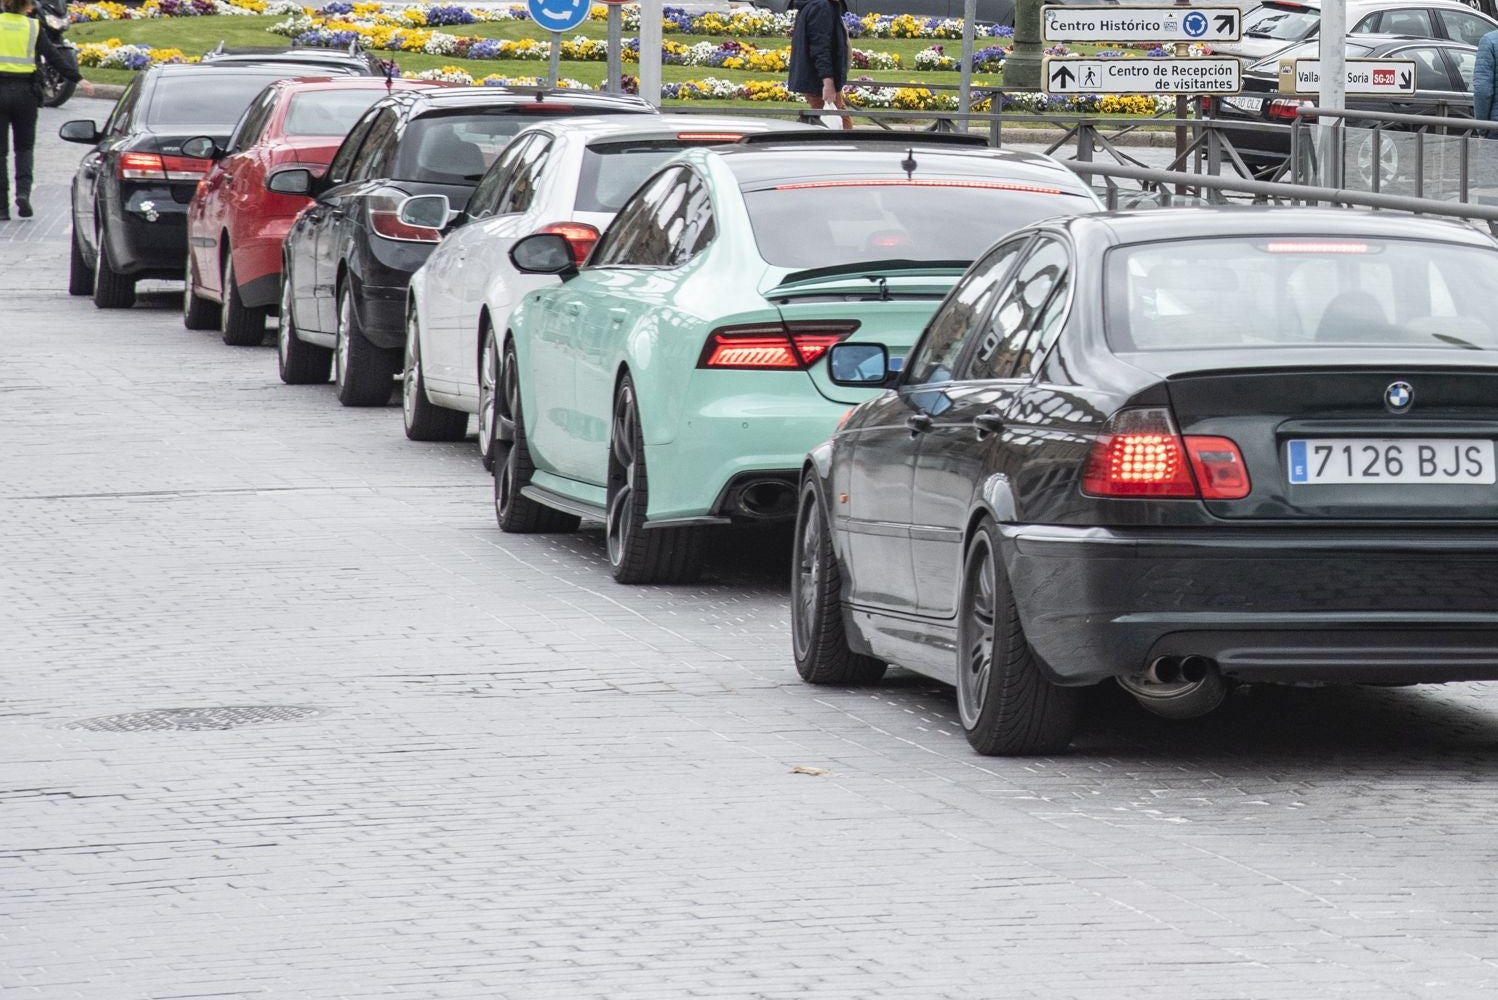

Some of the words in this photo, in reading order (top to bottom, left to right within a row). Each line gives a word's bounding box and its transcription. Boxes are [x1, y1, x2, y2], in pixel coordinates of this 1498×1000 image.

[1050, 20, 1095, 32] Centro
[1100, 18, 1160, 32] Histórico
[1108, 65, 1149, 77] Centro
[1153, 65, 1167, 77] de
[1172, 63, 1232, 80] Recepción
[1298, 71, 1320, 83] Valla
[1347, 71, 1369, 84] Soria
[1373, 73, 1395, 85] SG-20
[1155, 78, 1170, 90] de
[1174, 78, 1232, 90] visitantes
[1314, 445, 1404, 478] 7126
[1417, 445, 1484, 478] BJS
